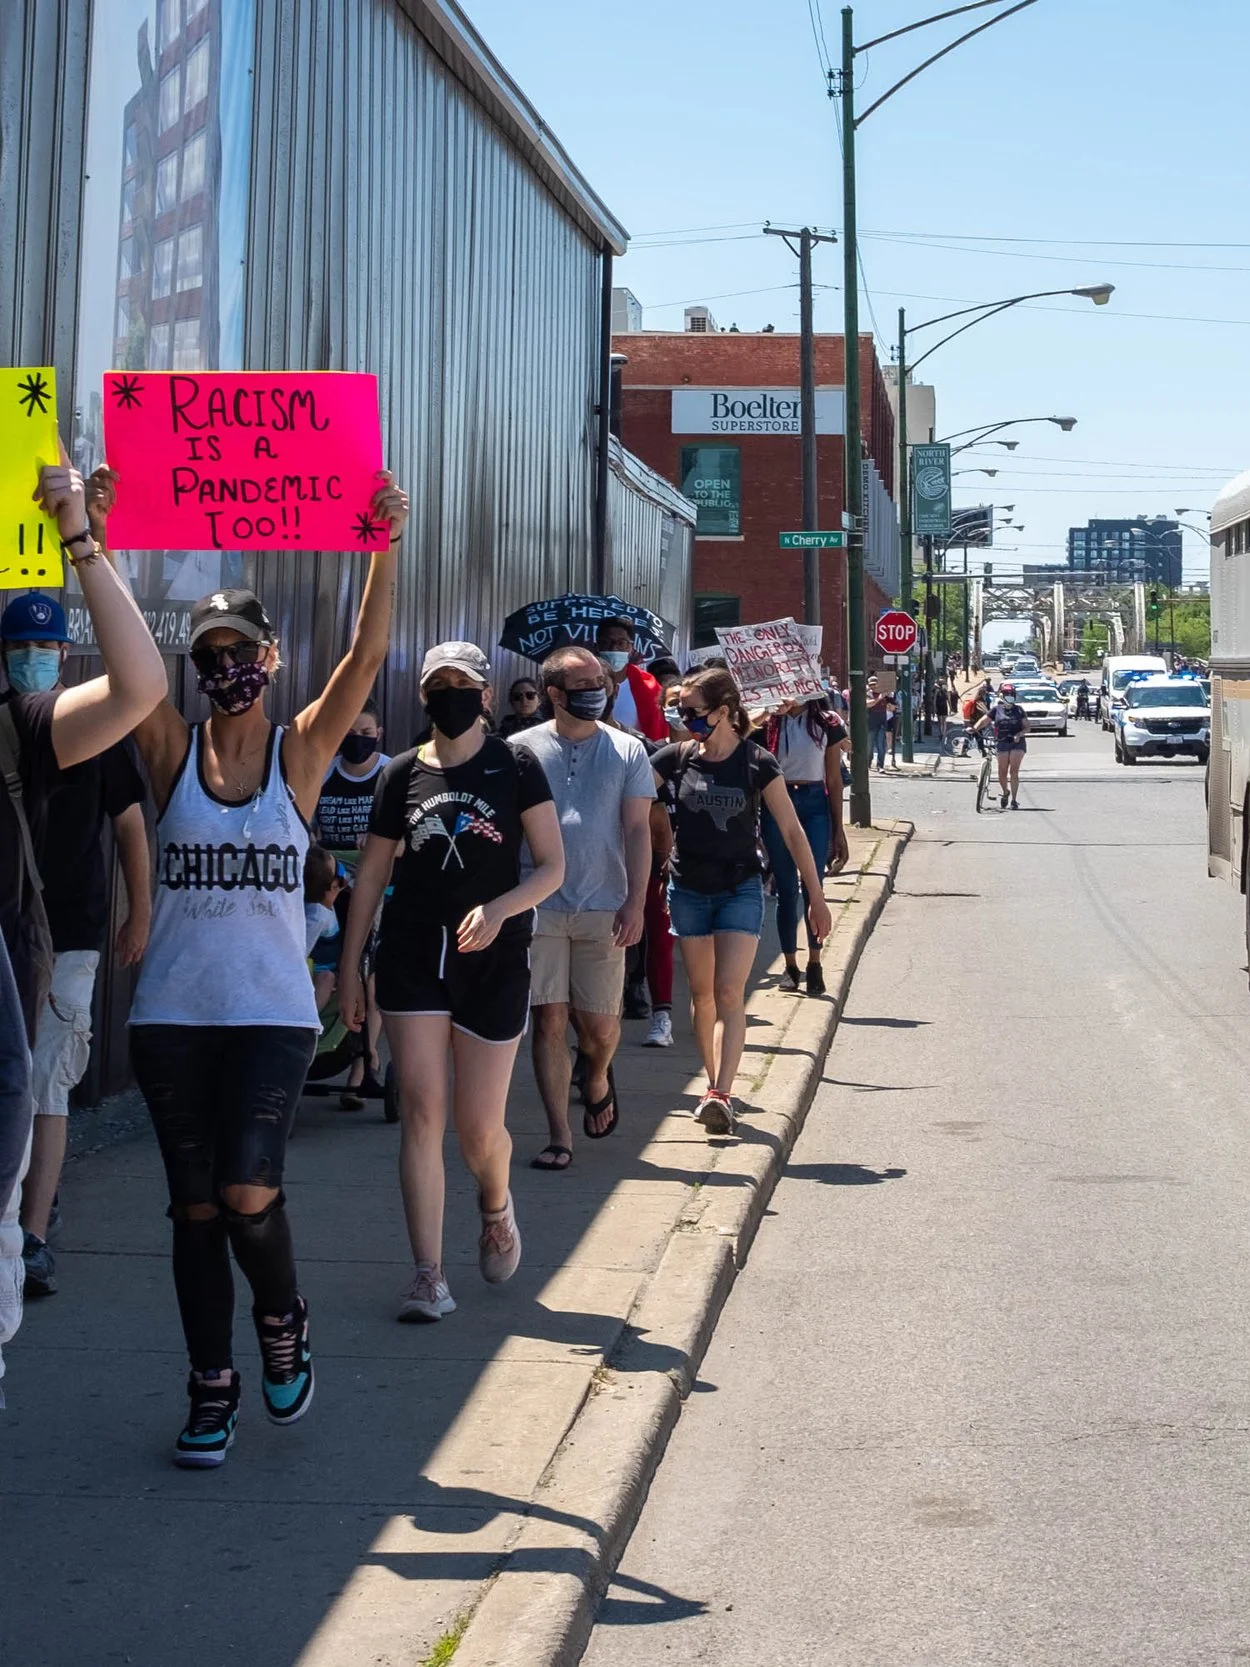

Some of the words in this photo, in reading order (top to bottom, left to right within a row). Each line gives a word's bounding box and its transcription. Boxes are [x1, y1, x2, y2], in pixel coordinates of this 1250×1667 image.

[169, 375, 330, 433] RACISM
[710, 393, 801, 419] Boelter
[712, 420, 799, 432] SUPERSTORE
[185, 436, 222, 461] IS
[254, 436, 278, 459] A
[916, 449, 946, 457] NORTH
[919, 457, 945, 465] RIVER
[172, 466, 343, 506] PANDEMIC
[694, 479, 731, 489] OPEN
[694, 490, 709, 498] TO
[711, 490, 731, 498] THE
[205, 506, 302, 549] TOO!!
[792, 535, 827, 546] Cherry
[528, 610, 558, 625] BE
[642, 608, 663, 628] TO
[519, 625, 559, 652] NOT
[719, 631, 747, 646] THE
[753, 623, 790, 641] ONLY
[878, 624, 915, 640] STOP
[731, 655, 812, 683] MINORITY
[740, 688, 762, 703] IS
[767, 681, 792, 698] THE
[794, 678, 823, 696] RICH
[409, 808, 424, 825] THE
[421, 791, 474, 812] HUMBOLDT
[473, 798, 496, 819] MILE
[696, 793, 744, 808] AUSTIN
[166, 842, 300, 893] CHICAGO
